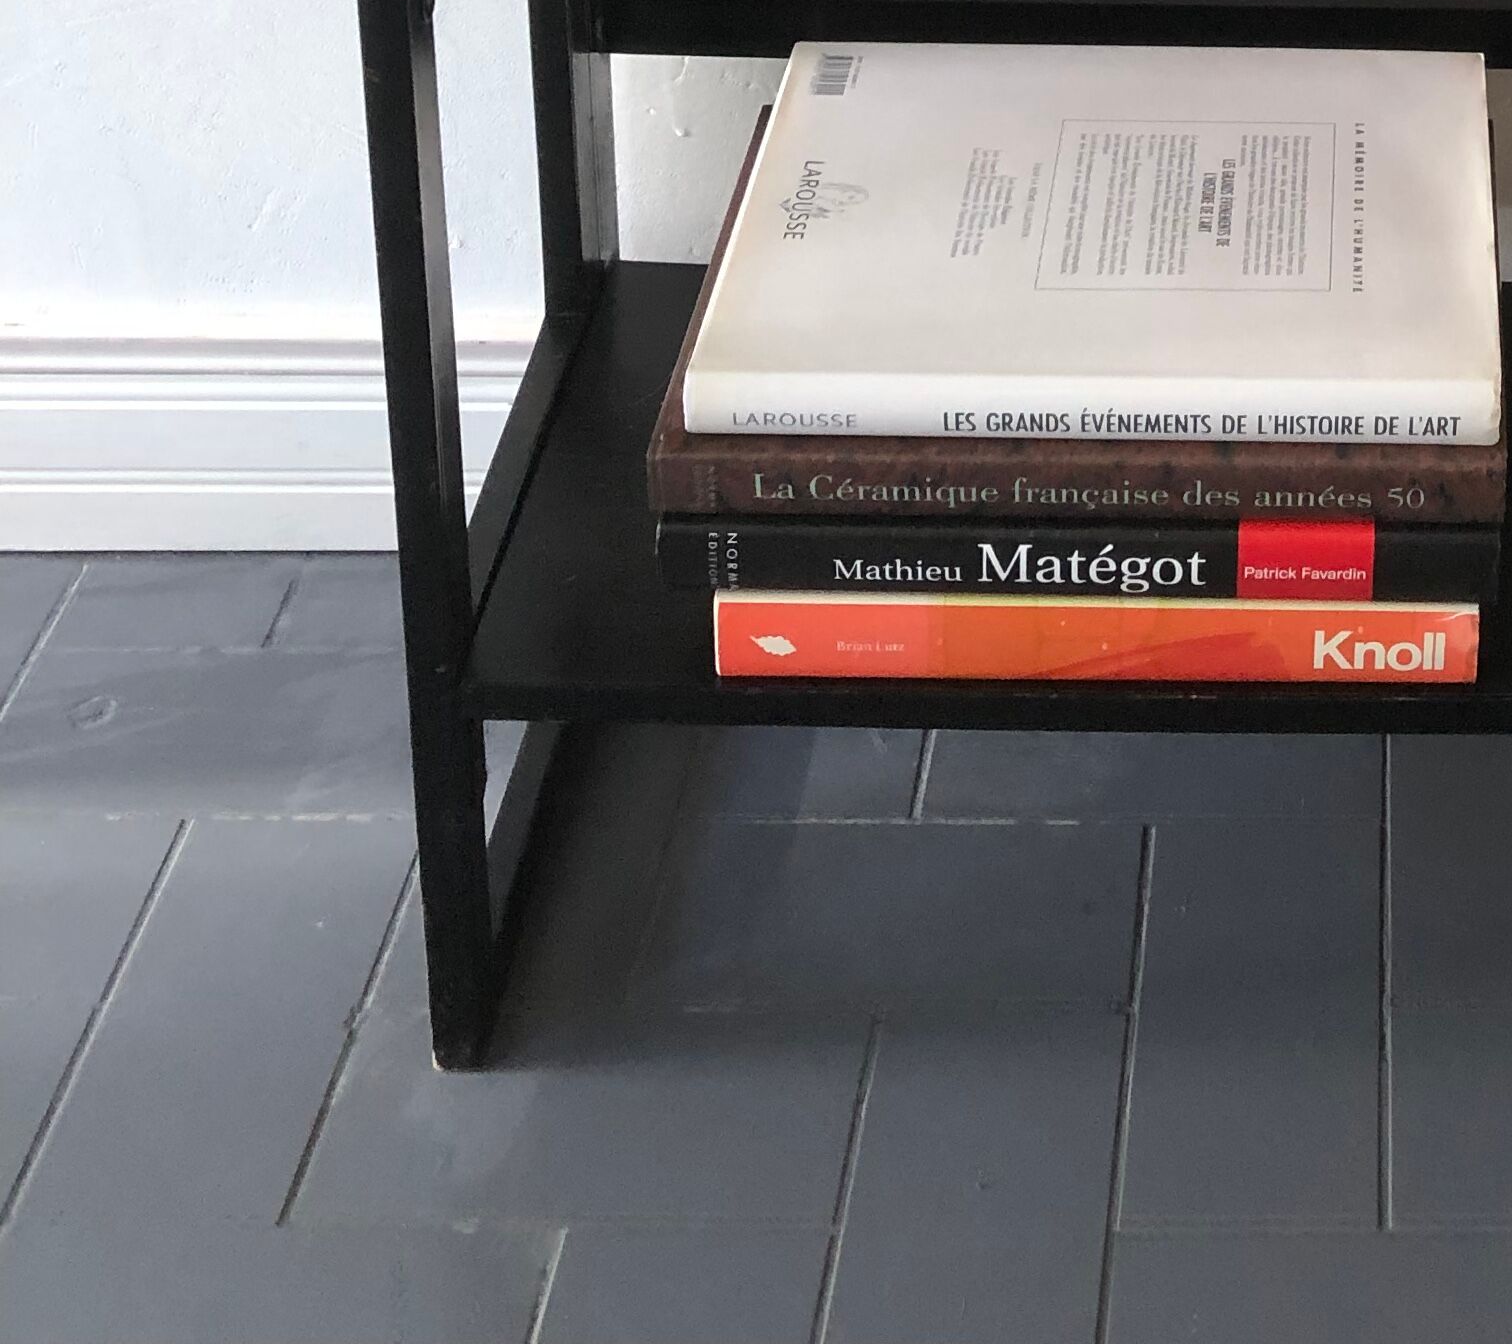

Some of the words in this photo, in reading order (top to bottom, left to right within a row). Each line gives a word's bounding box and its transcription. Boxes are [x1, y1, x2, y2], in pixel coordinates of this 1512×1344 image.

[1354, 122, 1365, 135] LA
[783, 160, 825, 240] LAROUSSE
[1353, 198, 1364, 212] DE
[732, 412, 857, 428] LAROUSSE
[943, 413, 976, 432] LES
[986, 413, 1071, 433] GRANDS
[1080, 408, 1211, 434] ÉVÉNEMENTS
[1222, 415, 1247, 434] DE
[1258, 415, 1364, 436] L'HISTOIRE
[1374, 416, 1399, 436] DE
[1408, 416, 1461, 437] L'ART
[753, 473, 794, 501] La
[809, 474, 999, 509] Céramique
[1013, 477, 1169, 511] française
[1183, 480, 1240, 507] des
[1254, 486, 1372, 510] années
[1387, 487, 1425, 510] 50
[726, 532, 739, 592] NORMA
[833, 558, 963, 582] Mathieu
[977, 543, 1206, 594] Matégot
[1244, 565, 1297, 580] Patrick
[1301, 565, 1367, 581] Favardin
[836, 640, 872, 652] Brian
[876, 640, 905, 652] Lutz
[1313, 629, 1446, 671] Knoll
